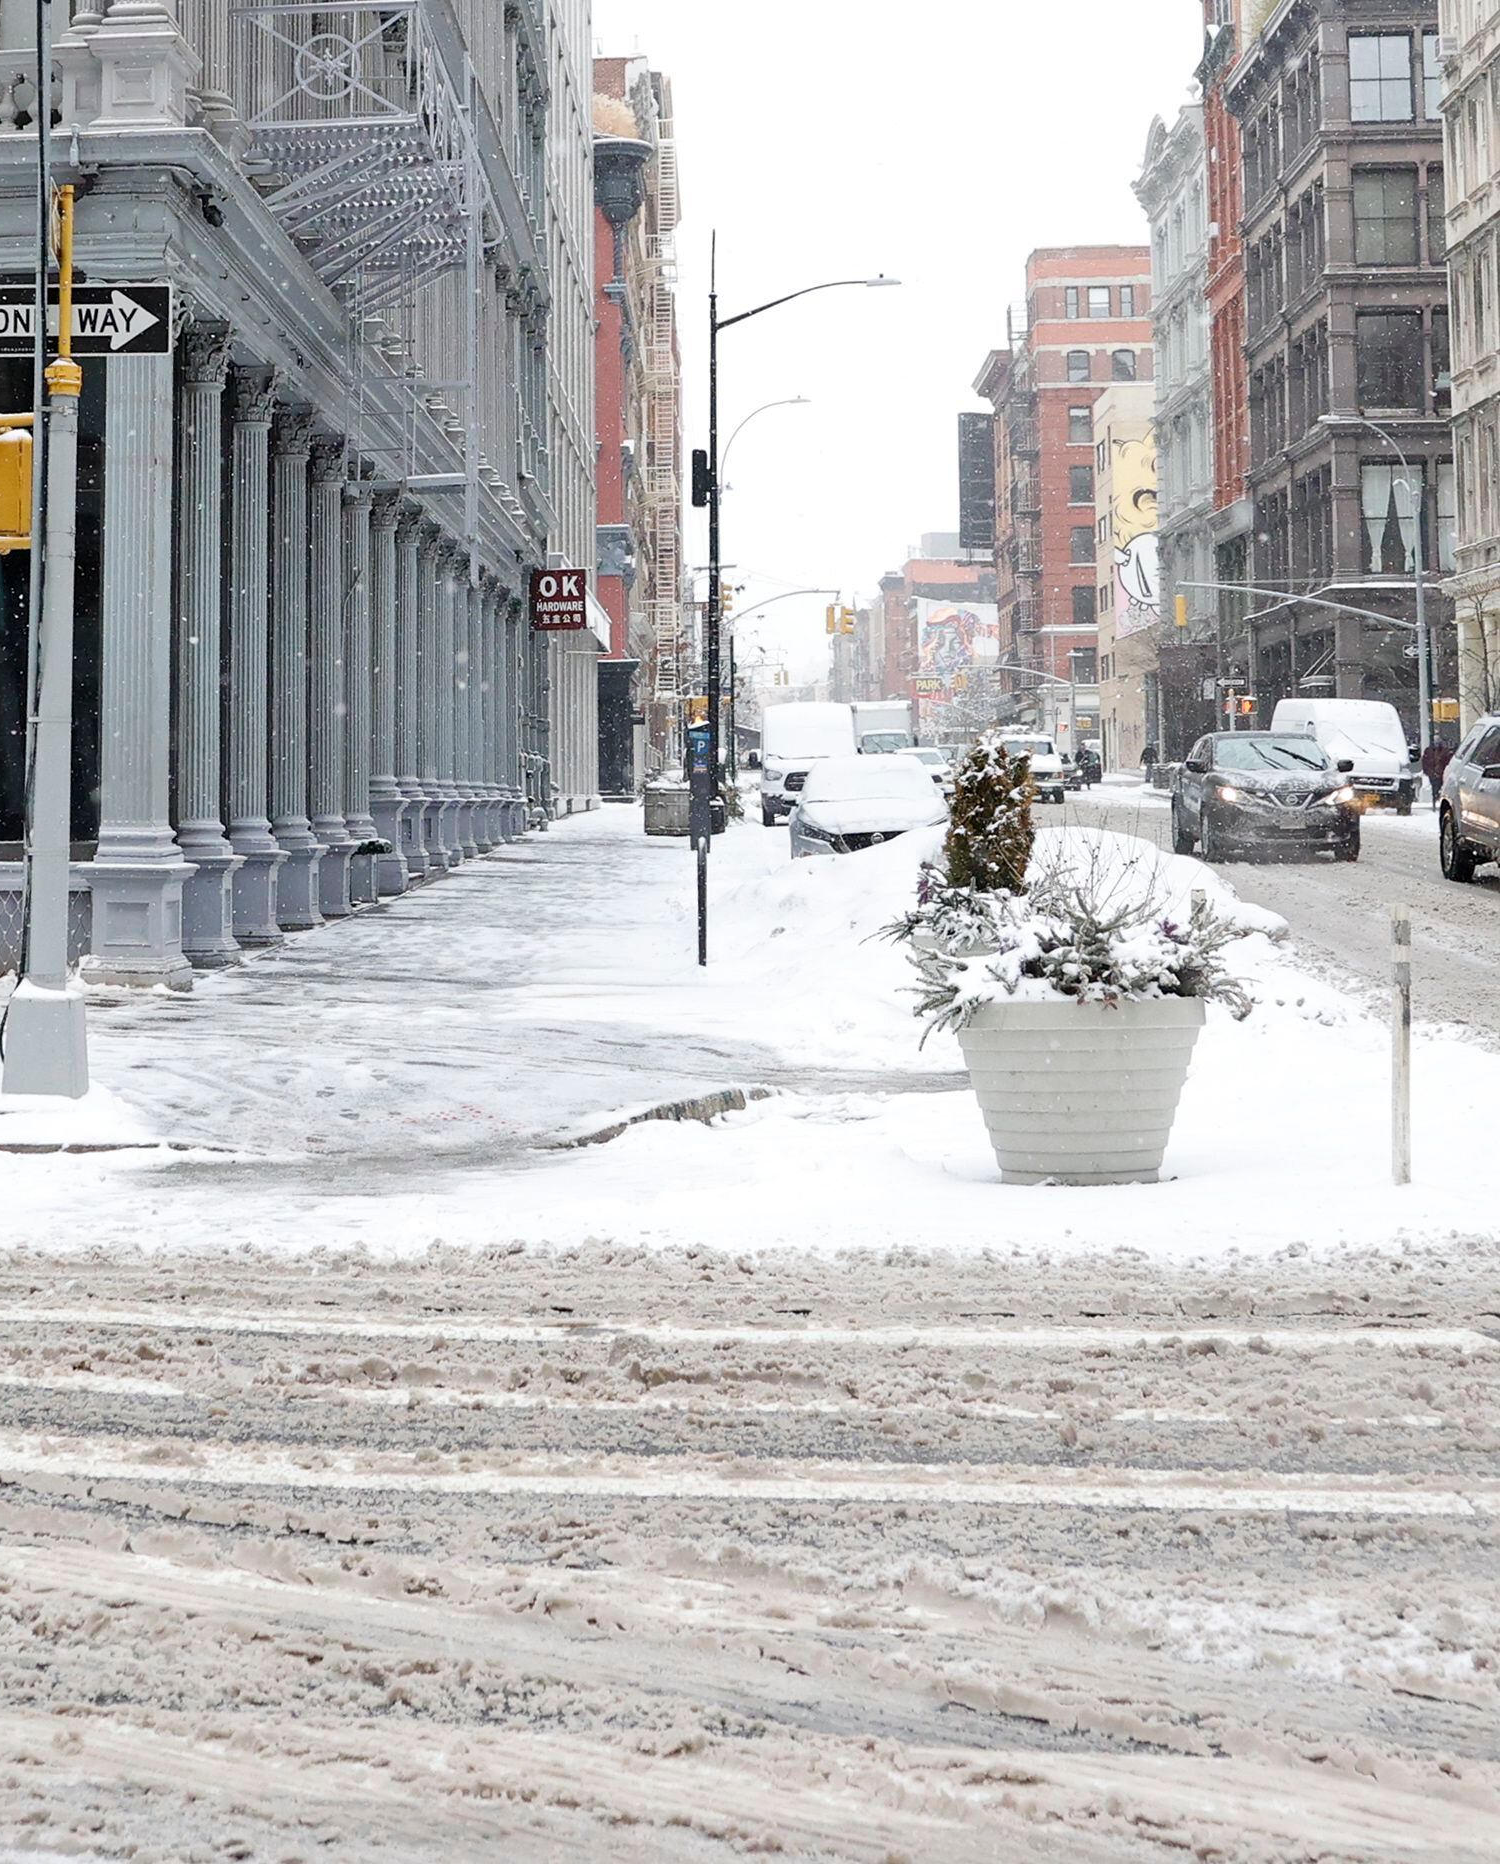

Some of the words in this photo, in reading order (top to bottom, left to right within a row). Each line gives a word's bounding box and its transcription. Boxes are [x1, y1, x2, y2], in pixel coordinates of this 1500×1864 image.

[78, 308, 138, 334] WAY
[539, 575, 580, 598] OK
[536, 600, 584, 612] HARDWARE
[542, 613, 582, 624] 五金公司
[916, 679, 941, 690] PARK
[698, 741, 706, 752] P
